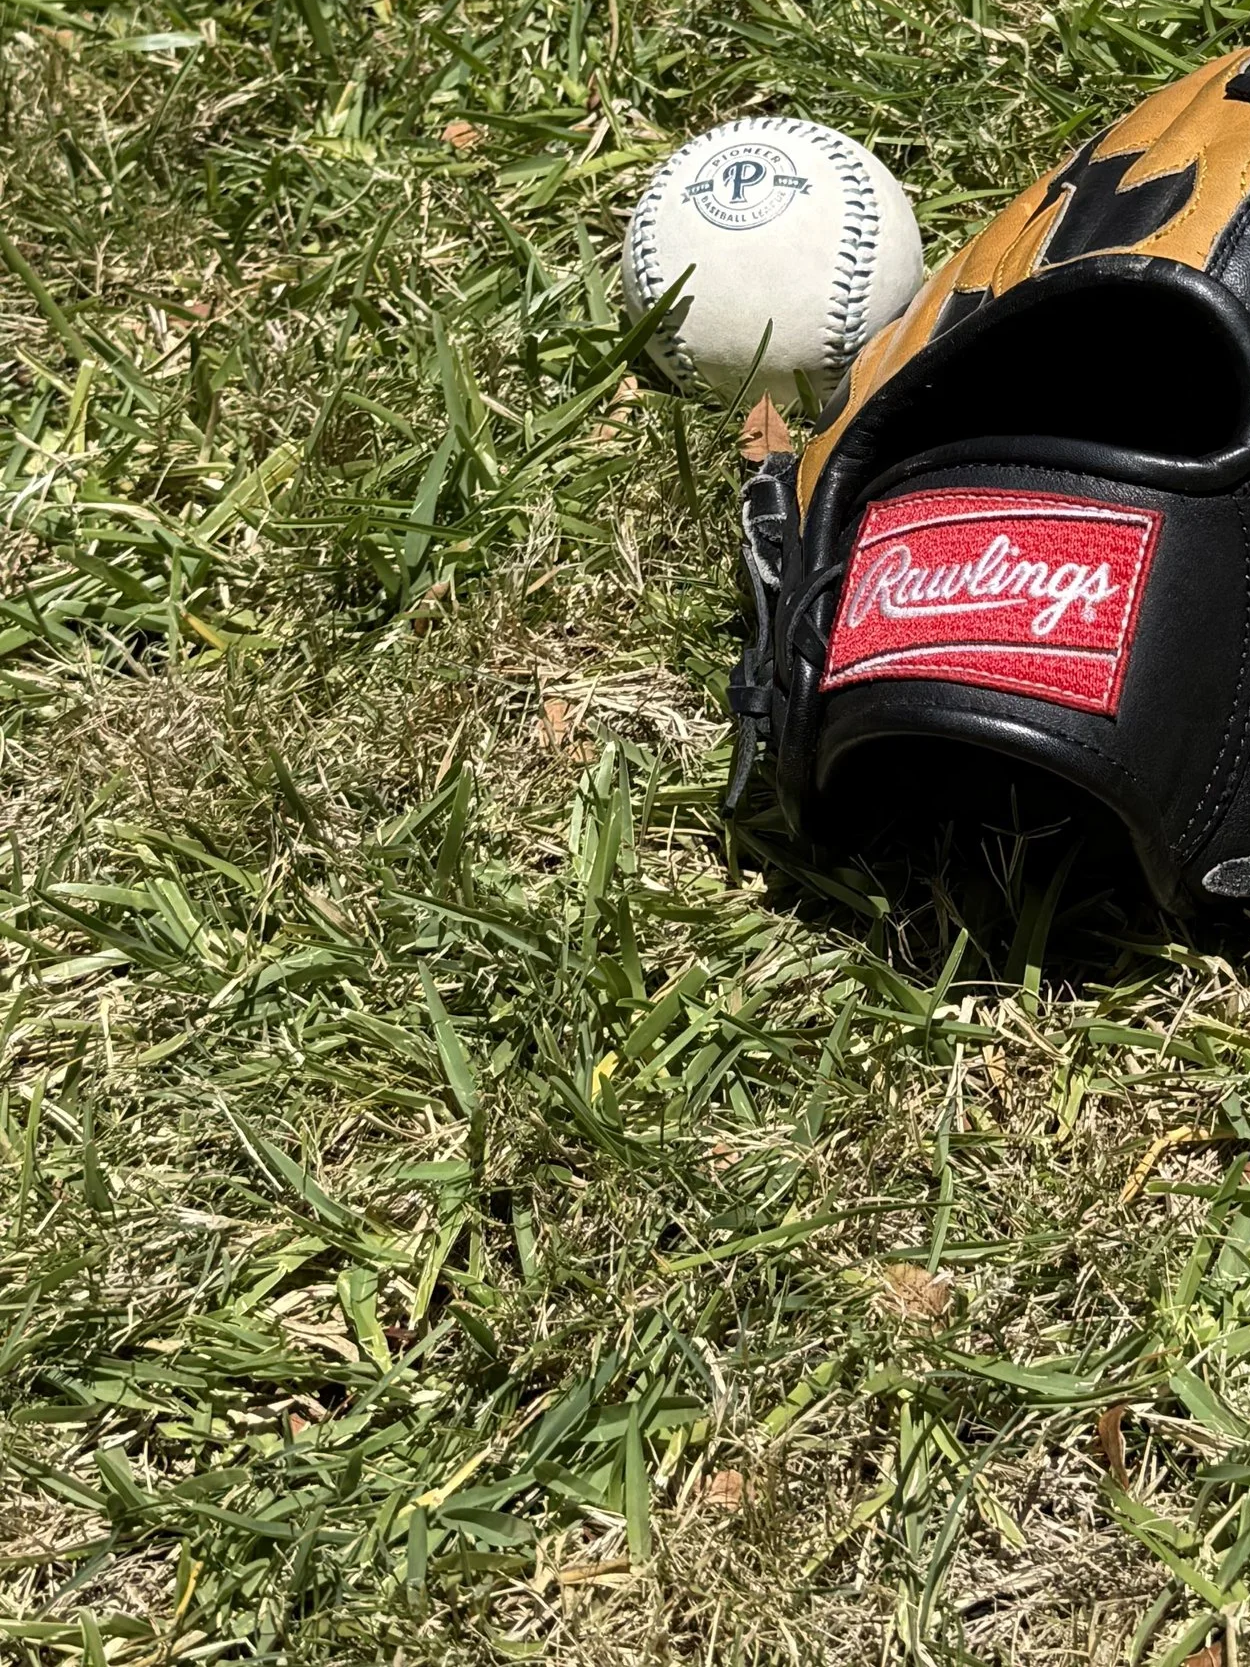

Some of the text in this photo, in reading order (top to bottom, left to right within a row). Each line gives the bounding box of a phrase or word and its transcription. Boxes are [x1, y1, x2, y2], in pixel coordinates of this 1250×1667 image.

[711, 147, 782, 167] PIONEER
[722, 160, 768, 205] P
[700, 195, 747, 223] BASEBALL
[846, 534, 1120, 636] Rawlings
